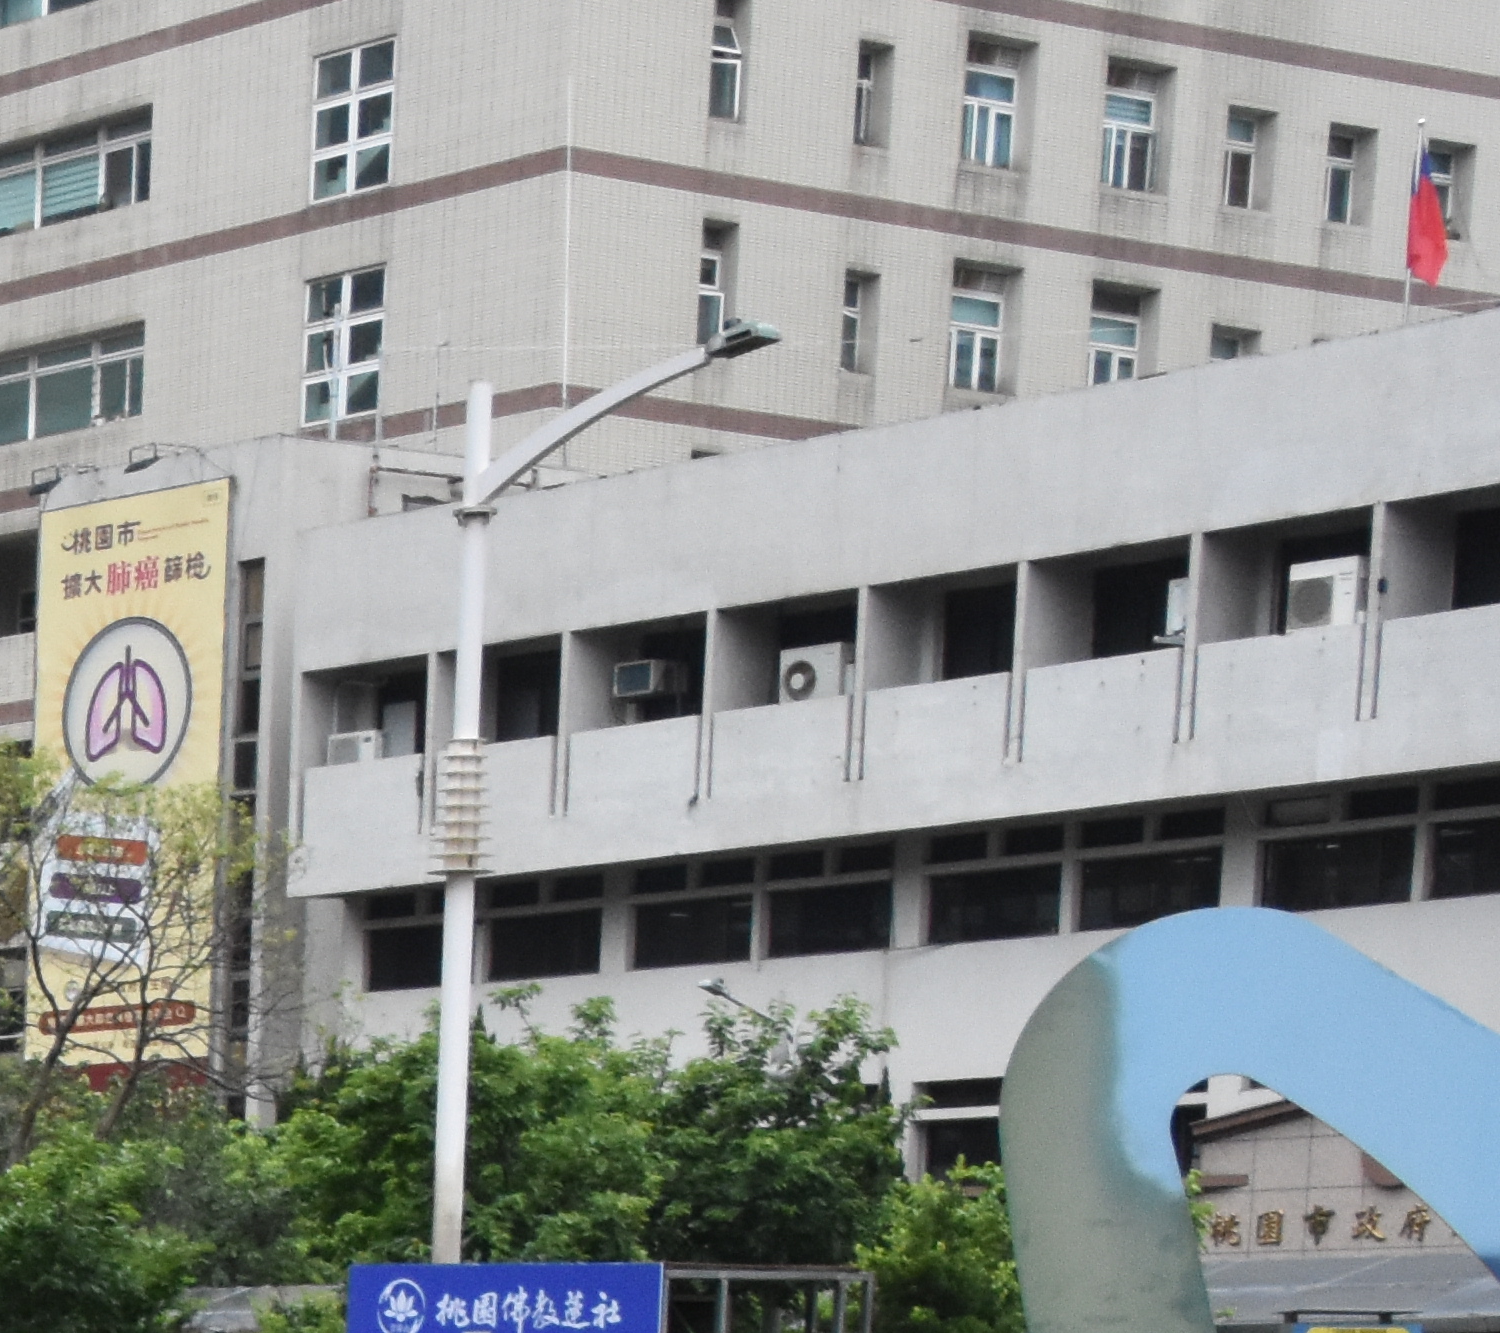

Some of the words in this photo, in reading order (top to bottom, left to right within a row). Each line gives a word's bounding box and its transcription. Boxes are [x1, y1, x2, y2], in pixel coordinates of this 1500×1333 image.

[70, 521, 141, 555] 桃園市
[1211, 1203, 1432, 1246] 桃園市政府
